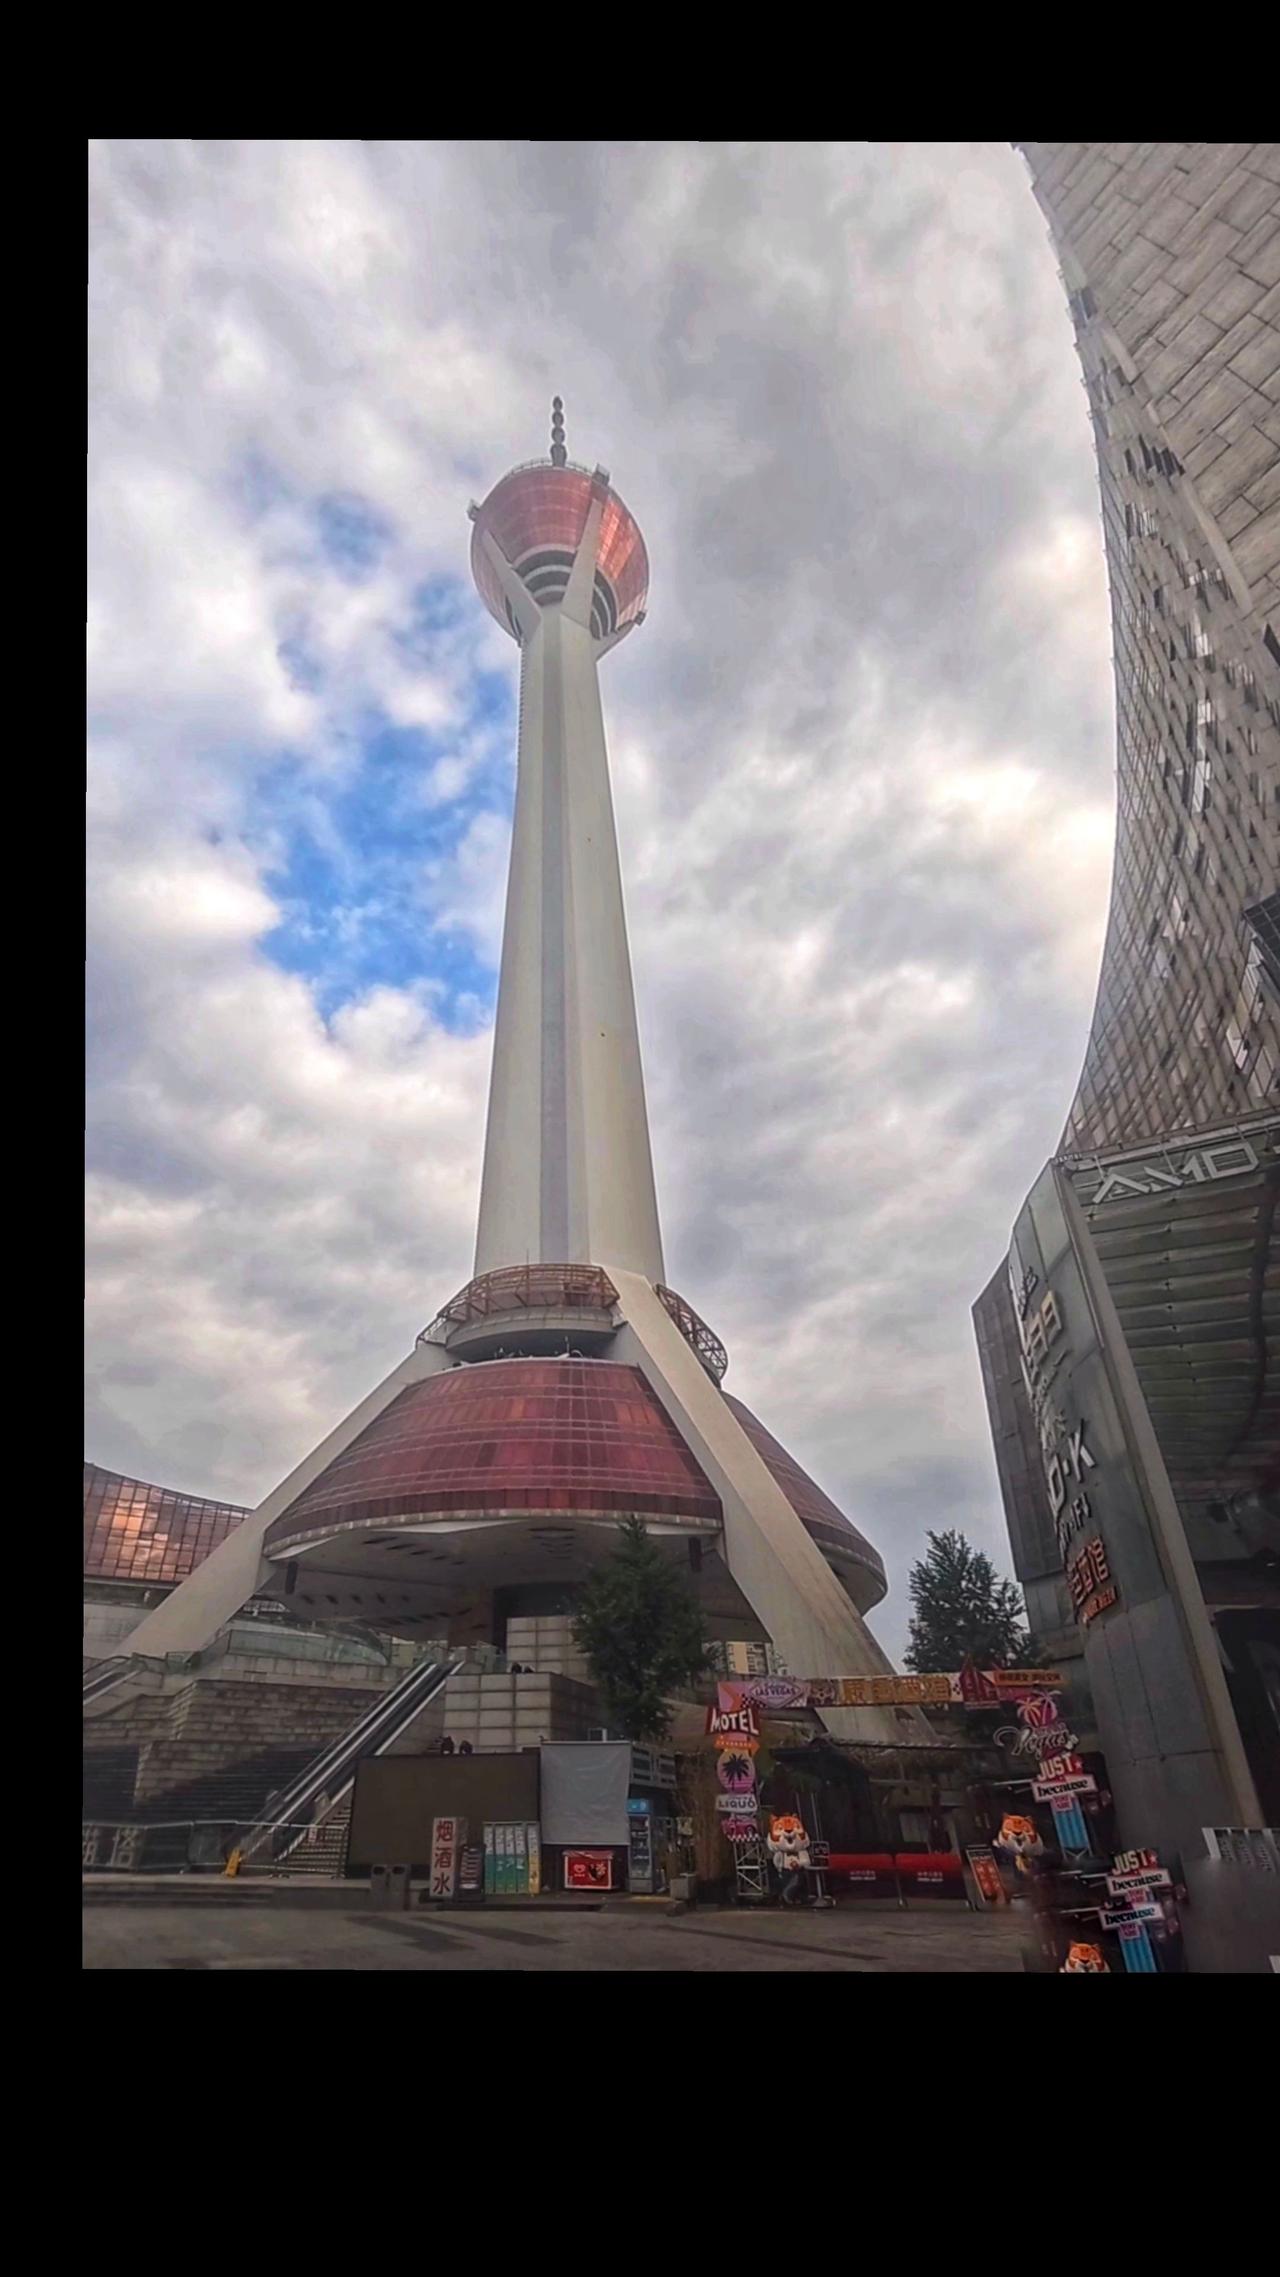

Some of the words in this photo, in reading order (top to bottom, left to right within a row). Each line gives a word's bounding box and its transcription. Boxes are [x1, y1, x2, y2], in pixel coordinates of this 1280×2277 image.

[711, 1707, 760, 1735] MOTEL
[1037, 1752, 1073, 1781] JUST
[1037, 1778, 1088, 1797] because
[434, 1820, 453, 1894] 烟酒水
[1111, 1847, 1148, 1875] JUST
[1112, 1873, 1162, 1891] because
[1104, 1907, 1155, 1925] because
